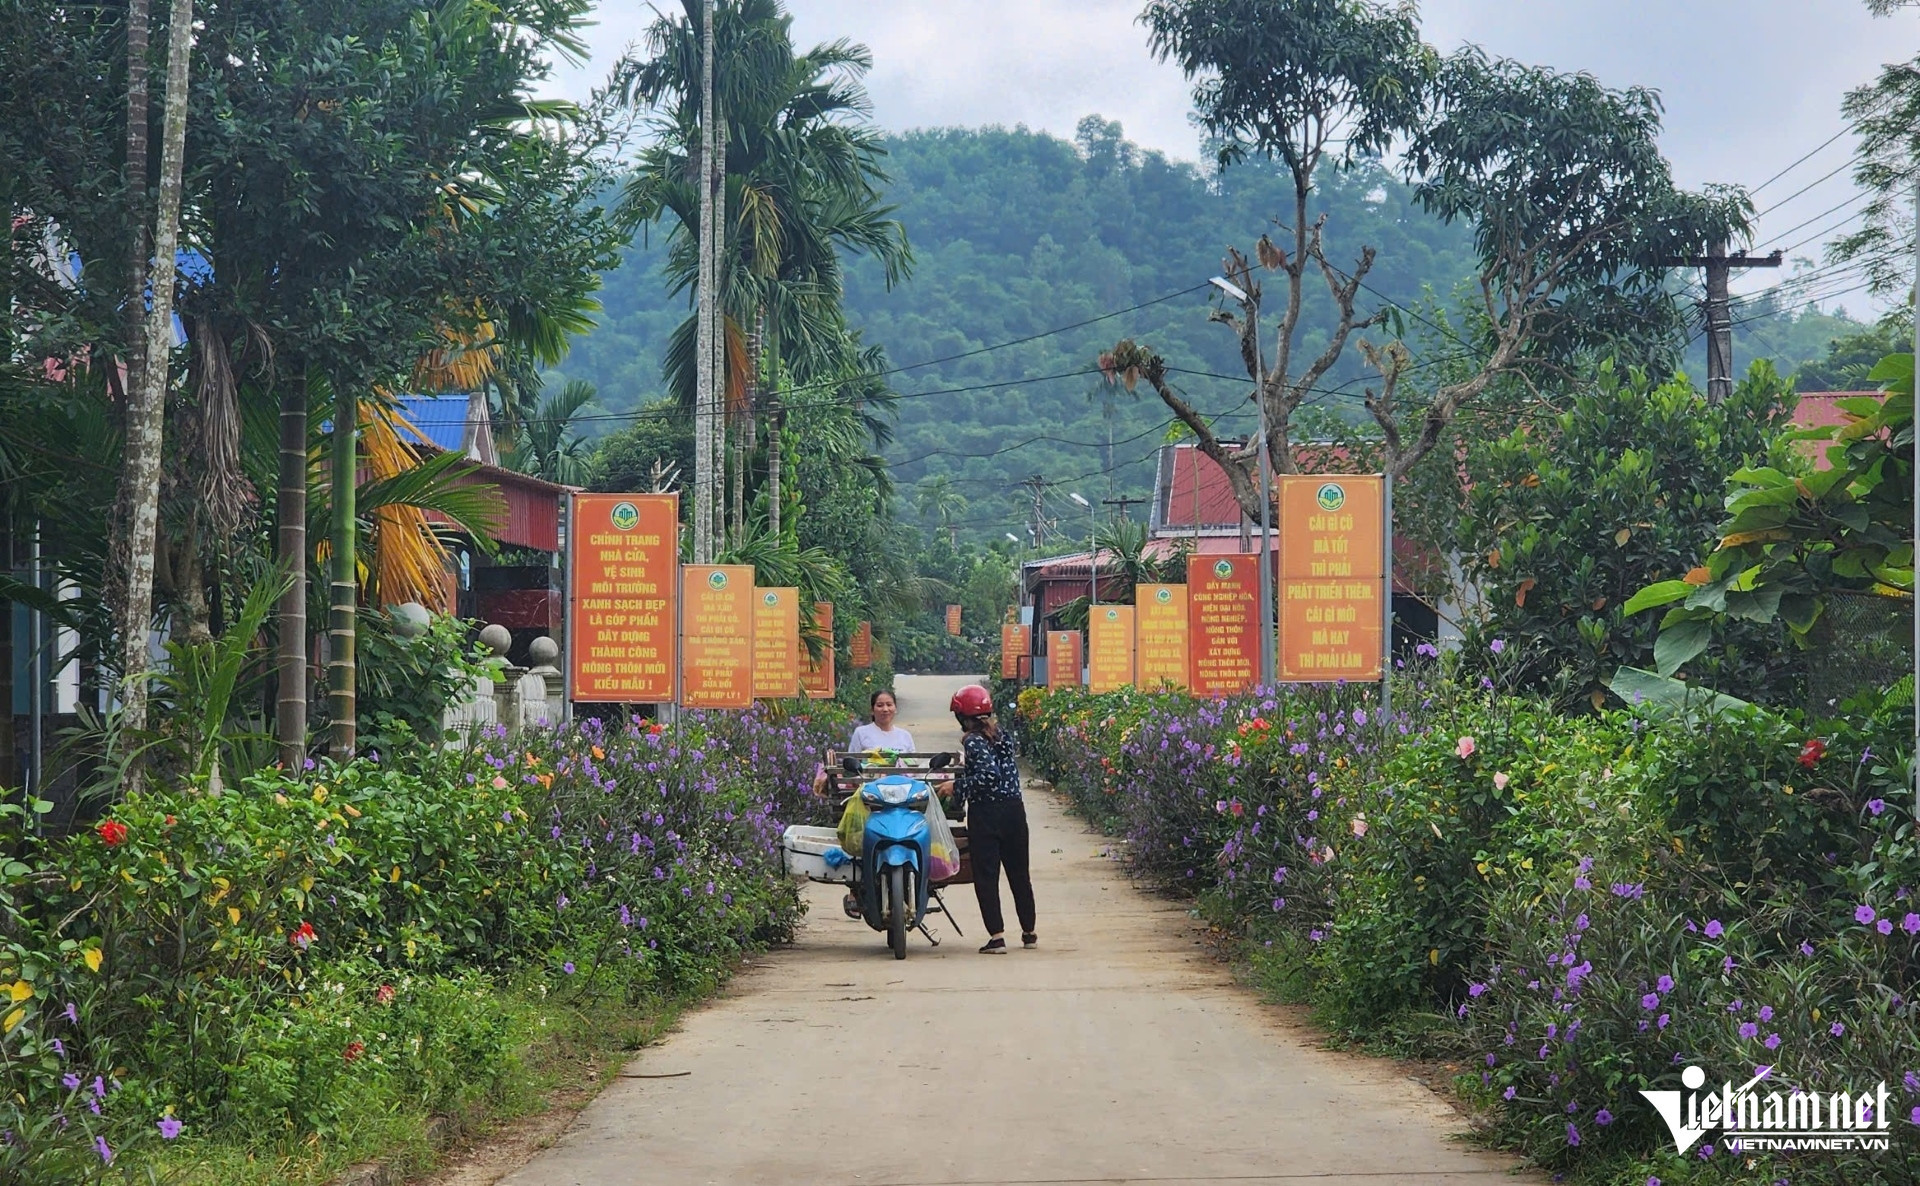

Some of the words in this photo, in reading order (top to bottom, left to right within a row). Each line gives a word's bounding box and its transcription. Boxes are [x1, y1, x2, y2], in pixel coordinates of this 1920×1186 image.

[1309, 514, 1325, 531] CÁI
[1328, 514, 1338, 531] GÌ
[590, 532, 622, 545] CHỈNH
[626, 535, 660, 546] TRANG
[1314, 536, 1329, 553] MÀ
[1332, 534, 1348, 554] TỐT
[600, 548, 622, 561] NHÀ
[625, 547, 649, 562] CỬA,
[604, 564, 617, 579] VỆ
[620, 567, 645, 577] SINH
[1311, 559, 1325, 576] THÌ
[1328, 557, 1351, 576] PHẢI
[592, 581, 612, 593] MÔI
[616, 580, 656, 593] TRƯỜNG
[1288, 582, 1312, 599] PHÁT
[1315, 580, 1342, 599] TRIỂN
[582, 599, 611, 609] XANH
[614, 599, 642, 611] SẠCH
[645, 599, 666, 612] ĐẸP
[1306, 605, 1322, 622] CÁI
[1325, 605, 1335, 622] GÌ
[1337, 604, 1356, 622] MỚI
[590, 613, 602, 625] LÀ
[606, 613, 627, 625] GÓP
[629, 612, 658, 625] PHẦN
[621, 631, 650, 643] DỰNG
[1312, 628, 1328, 645] MÀ
[1330, 630, 1349, 645] HAY
[590, 645, 625, 657] THÀNH
[628, 646, 657, 658] CÔNG
[1299, 650, 1314, 668] THÌ
[1317, 648, 1339, 668] PHẢI
[1342, 651, 1362, 668] LÀM
[582, 661, 611, 673] NÔNG
[615, 662, 642, 673] THÔN
[645, 661, 666, 674] MỚI
[594, 675, 618, 689] KIỂU
[621, 677, 645, 690] MẪU
